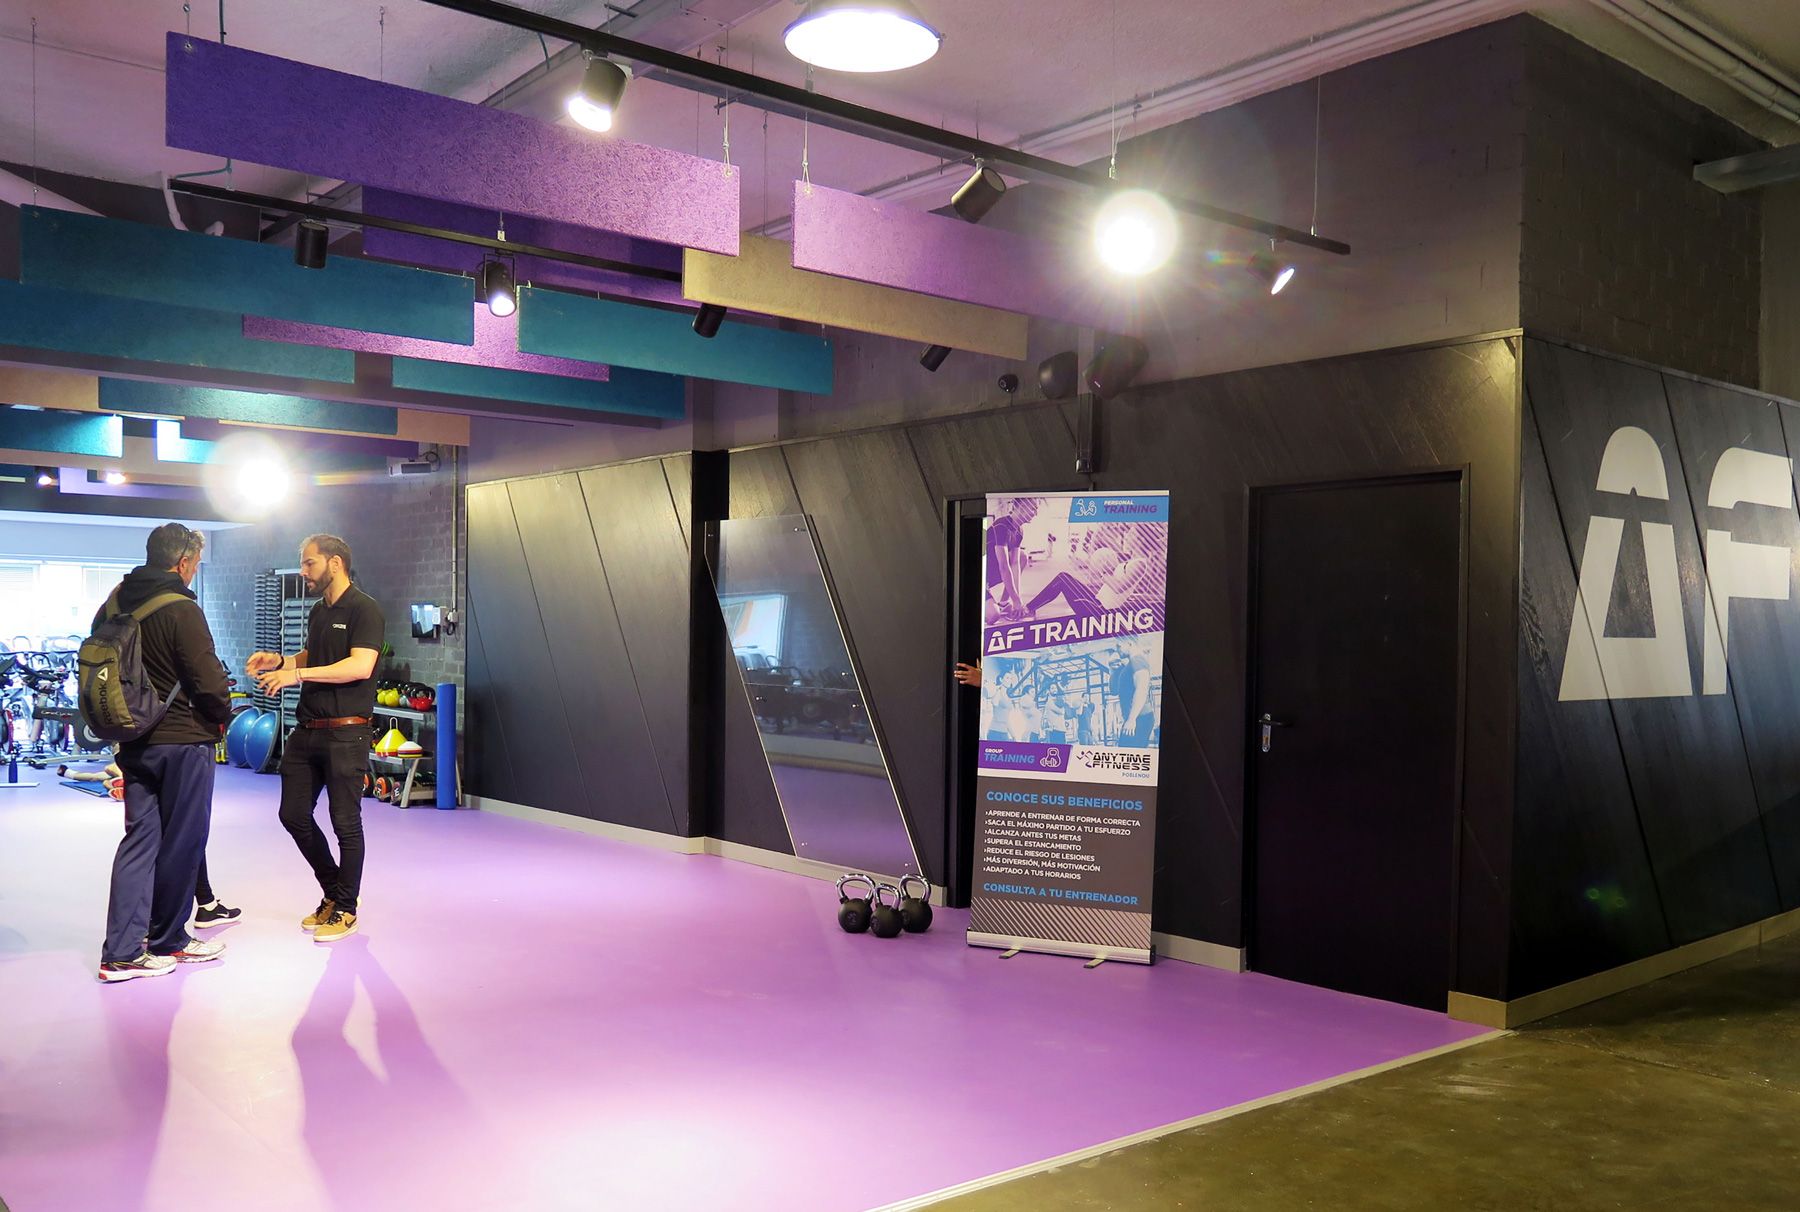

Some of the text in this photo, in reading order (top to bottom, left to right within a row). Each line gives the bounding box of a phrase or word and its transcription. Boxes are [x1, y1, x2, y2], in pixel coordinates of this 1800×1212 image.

[1104, 505, 1157, 514] TRAINING
[1558, 426, 1793, 701] AF
[988, 608, 1153, 652] AF TRAINING
[985, 753, 1035, 764] TRAINING
[986, 791, 1143, 810] CONOCE SUS BENEFICIOS
[1028, 812, 1064, 821] ENTRENAR
[1102, 818, 1140, 826] CORRECTA
[1016, 820, 1044, 828] MÁXIMO
[1094, 826, 1130, 836] ESFUERZO
[1024, 840, 1082, 850] ESTANCAMIENTO
[1024, 850, 1050, 858] RIESGO
[1062, 854, 1095, 862] LESIONES
[1002, 858, 1040, 868] DIVERSIÓN,
[1041, 860, 1056, 868] MÁS
[1056, 862, 1100, 872] MOTIVACIÓN
[1044, 871, 1082, 880] HORARIOS
[984, 883, 1138, 904] CONSULTA A TU ENTRENADOR
